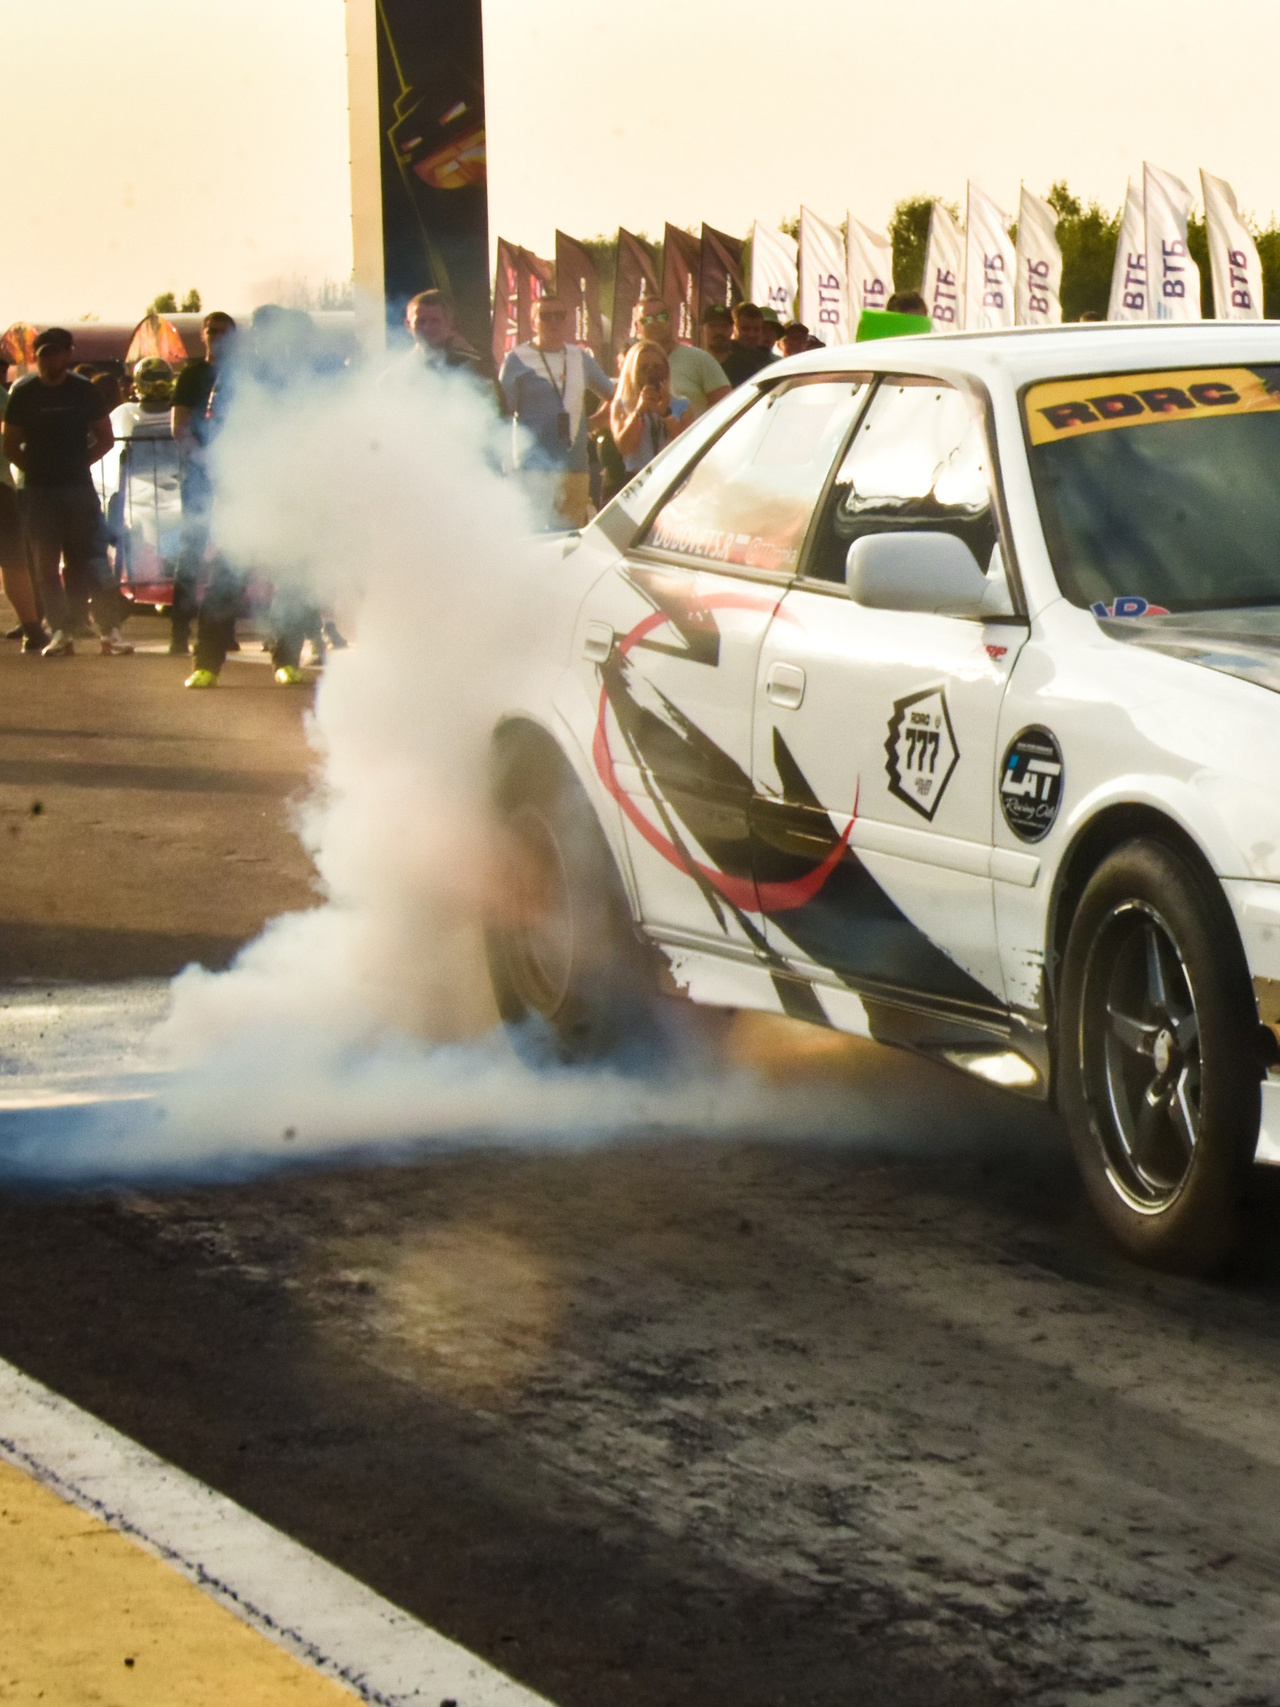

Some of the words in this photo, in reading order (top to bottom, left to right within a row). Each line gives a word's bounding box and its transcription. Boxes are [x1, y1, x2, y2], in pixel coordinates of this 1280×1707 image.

[863, 278, 885, 309] ТБ
[932, 267, 956, 323] ВТБ
[983, 253, 1004, 309] ВТБ
[1027, 257, 1050, 315] ВТБ
[1123, 252, 1146, 311] ВТБ
[1162, 239, 1186, 298] ВТБ
[1228, 249, 1251, 309] ВТБ
[768, 286, 789, 315] ТБ
[819, 274, 840, 325] ВТБ
[1036, 382, 1241, 430] RDRC
[905, 728, 940, 774] 777
